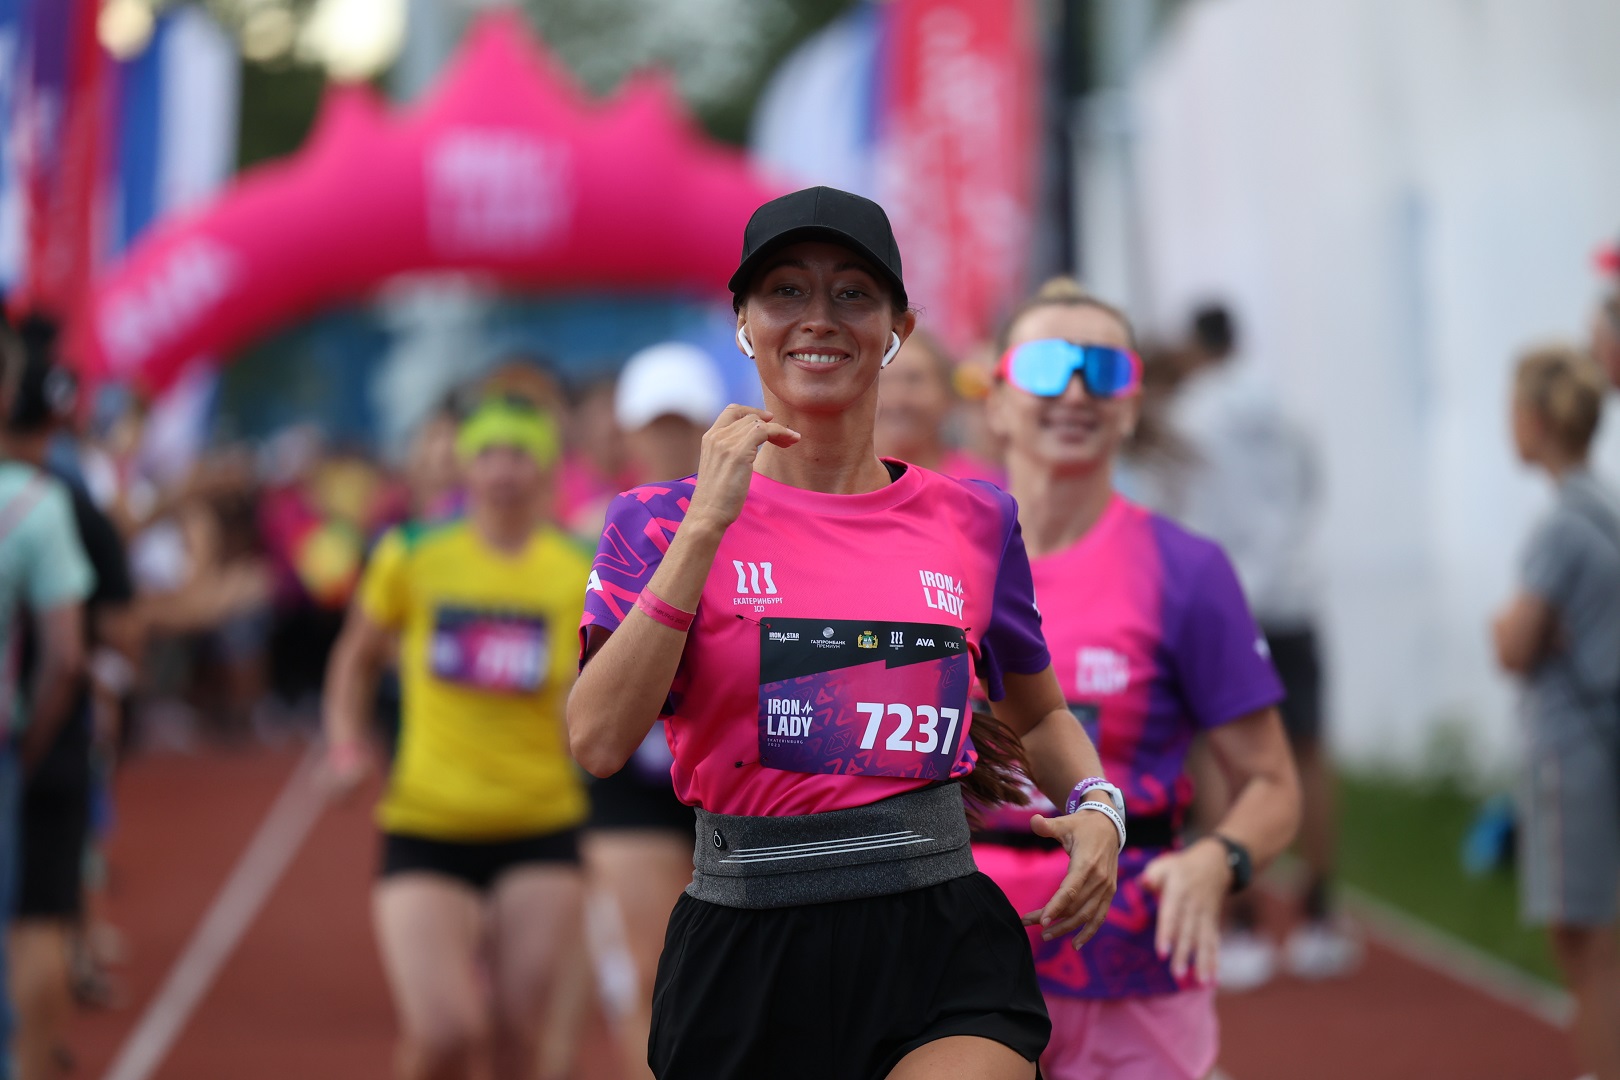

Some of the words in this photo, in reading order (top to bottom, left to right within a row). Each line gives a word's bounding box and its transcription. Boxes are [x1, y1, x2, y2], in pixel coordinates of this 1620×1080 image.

[919, 570, 954, 593] IRON
[733, 597, 783, 606] ЕКАТЕРИНБУРГ
[923, 587, 964, 620] LADY
[915, 638, 935, 647] AVA
[944, 641, 960, 649] VOICE
[768, 698, 800, 715] IRON
[767, 715, 813, 737] LADY
[856, 702, 960, 755] 7237
